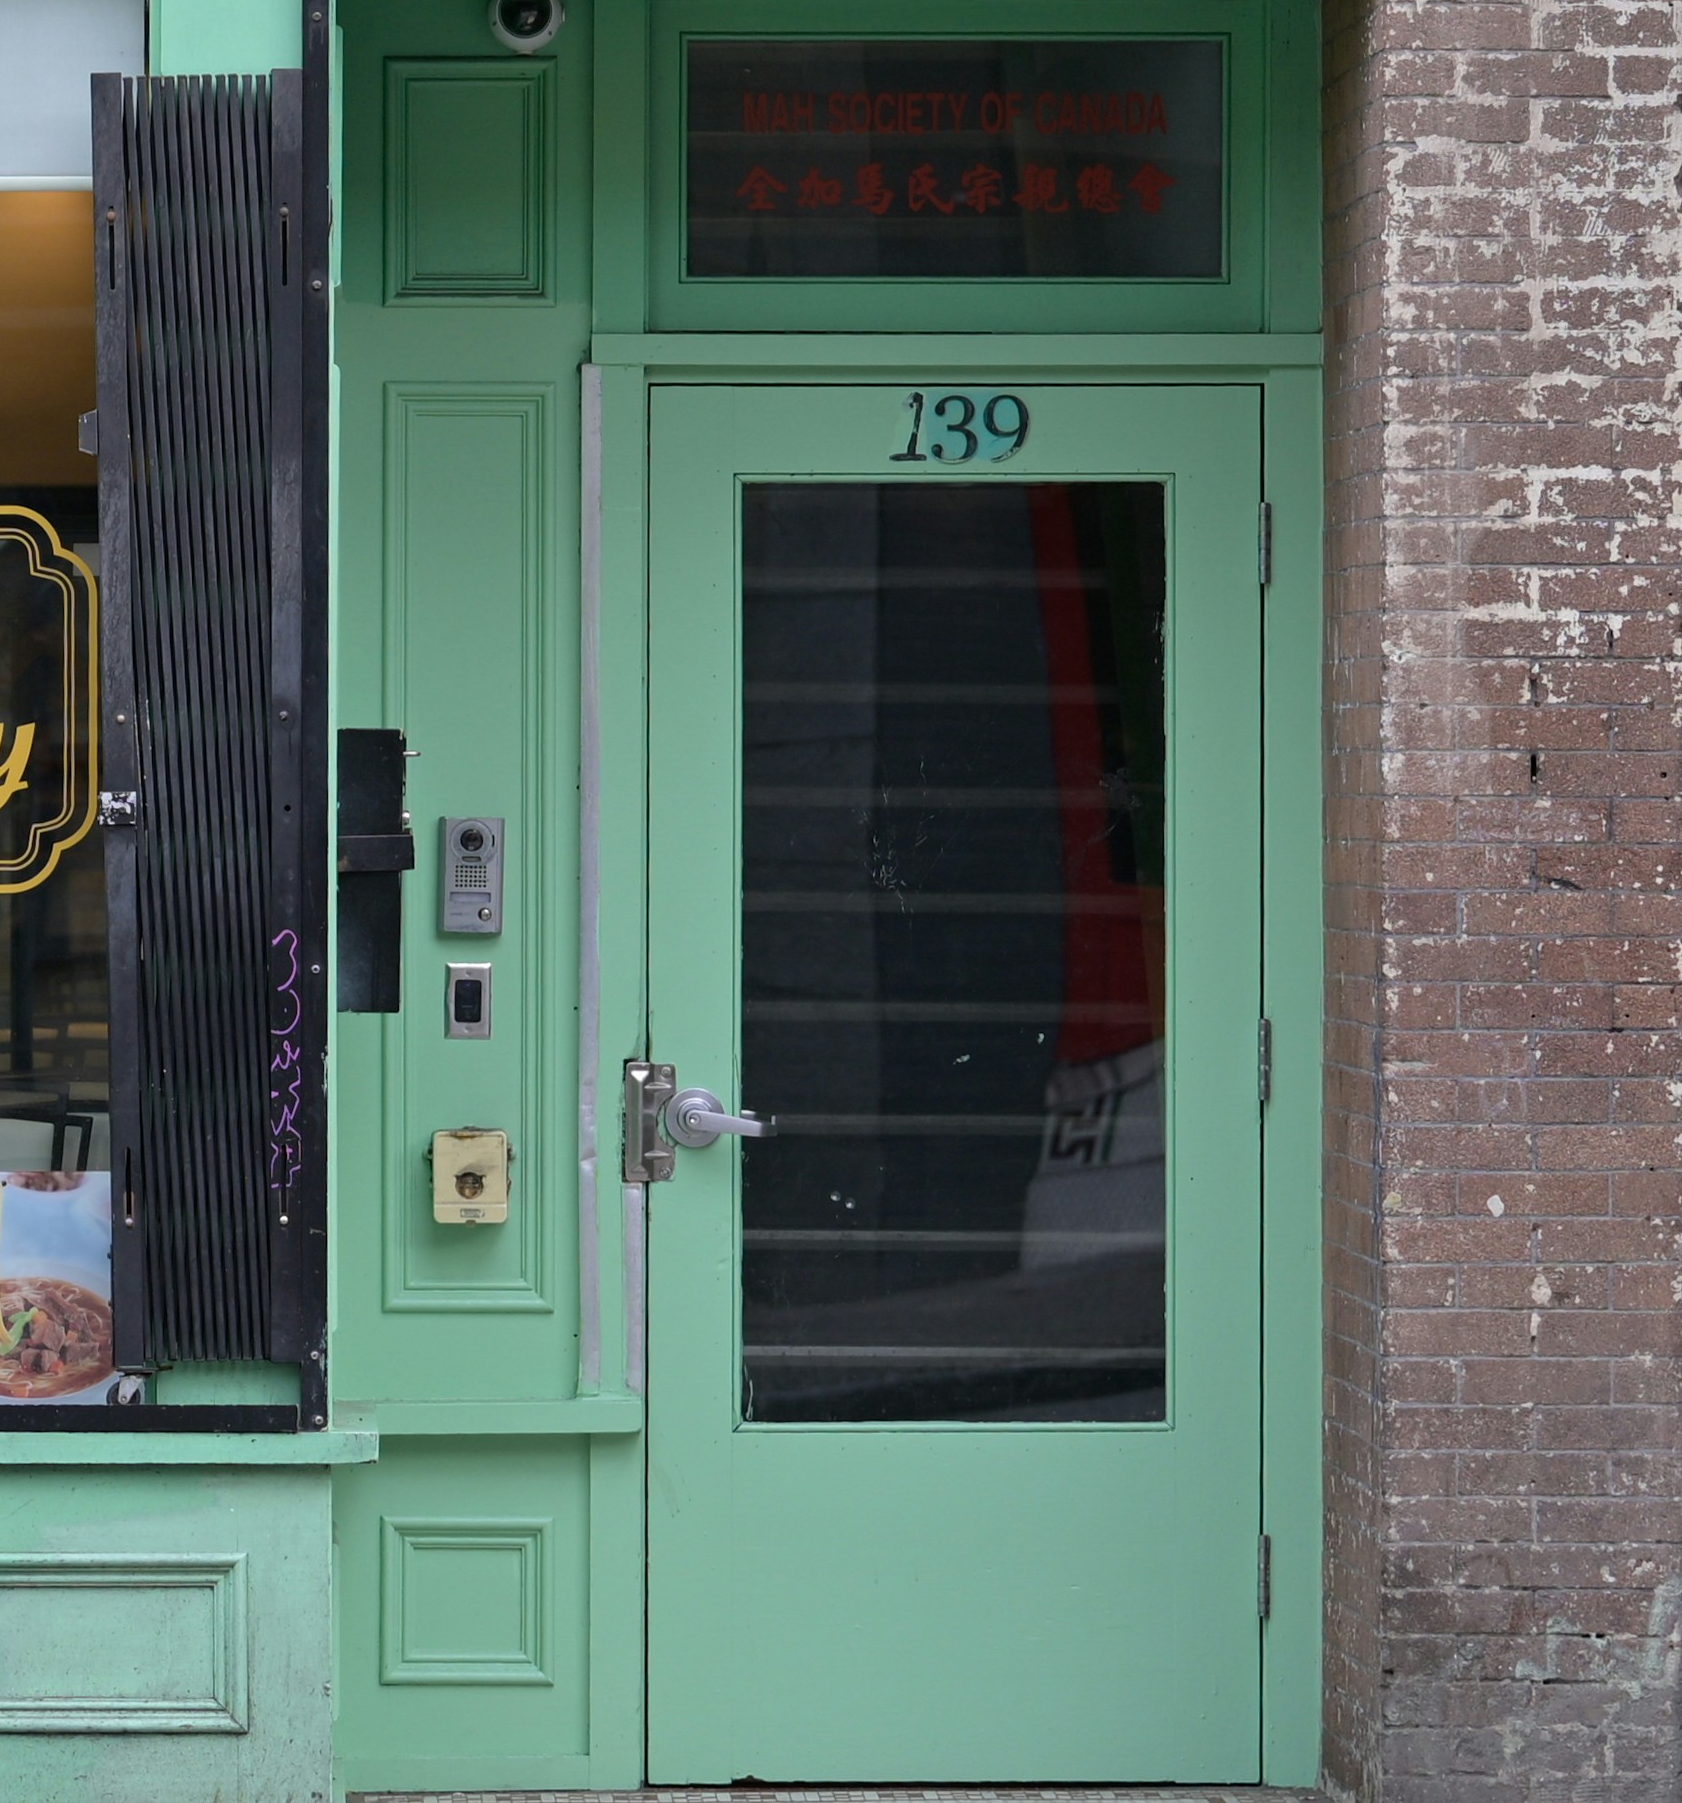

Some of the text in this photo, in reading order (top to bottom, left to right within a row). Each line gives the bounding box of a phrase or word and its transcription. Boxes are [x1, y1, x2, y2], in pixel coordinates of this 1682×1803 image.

[742, 91, 1169, 136] MAH SOCIETY OF CANADA
[888, 391, 1031, 465] 139
